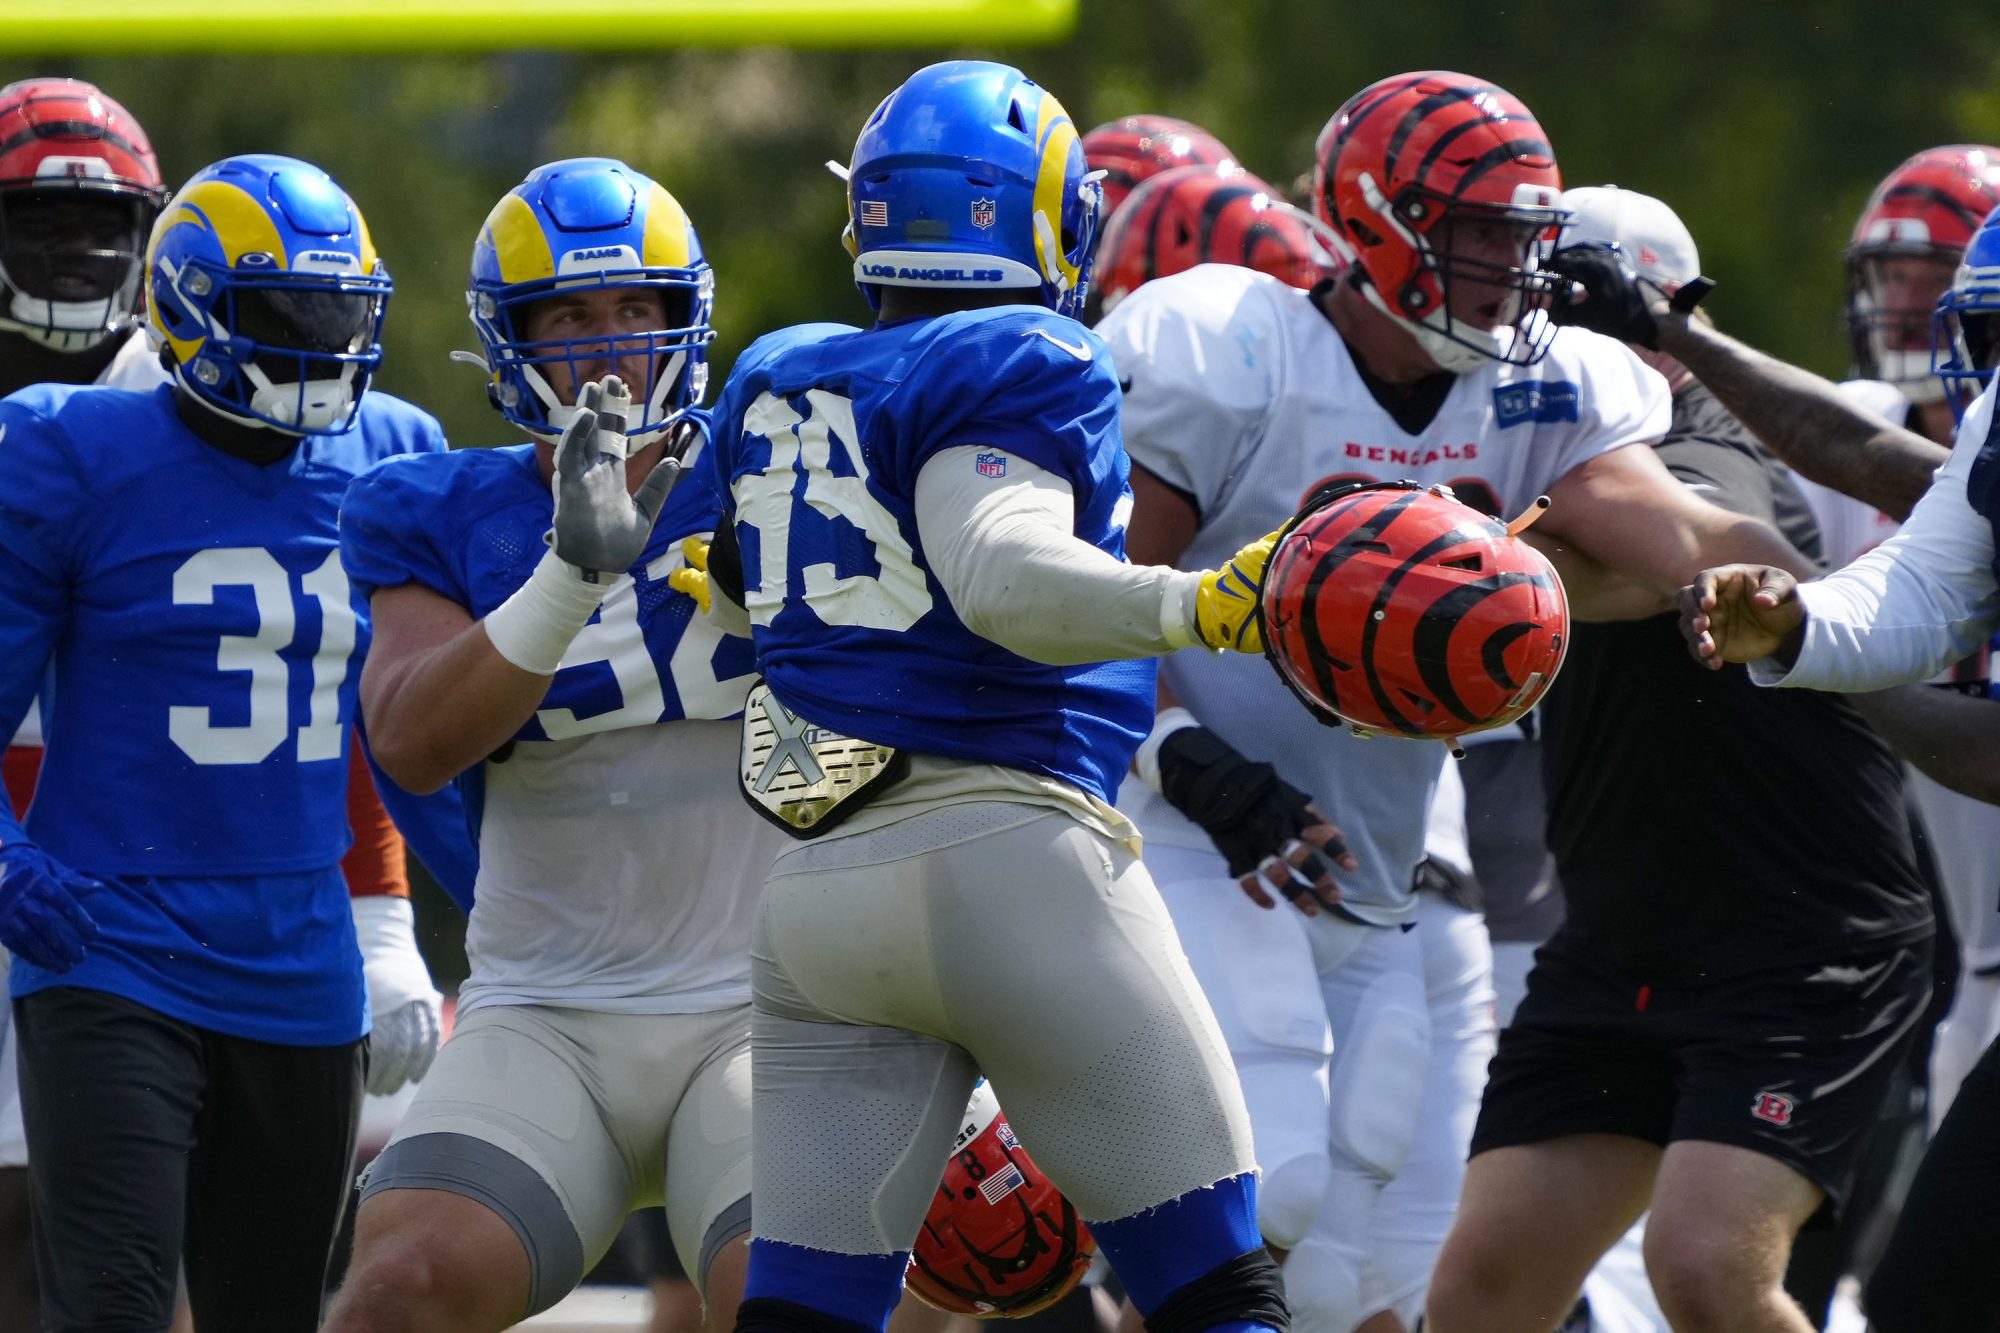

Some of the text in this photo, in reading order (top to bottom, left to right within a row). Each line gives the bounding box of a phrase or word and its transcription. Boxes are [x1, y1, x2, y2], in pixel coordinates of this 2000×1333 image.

[975, 211, 993, 225] NFL
[309, 253, 351, 265] RAMS
[573, 247, 622, 261] RAMS
[862, 264, 1003, 282] LOS ANGELES
[1345, 442, 1478, 466] BENGALS
[979, 463, 1003, 476] NFL
[168, 546, 357, 765] 31
